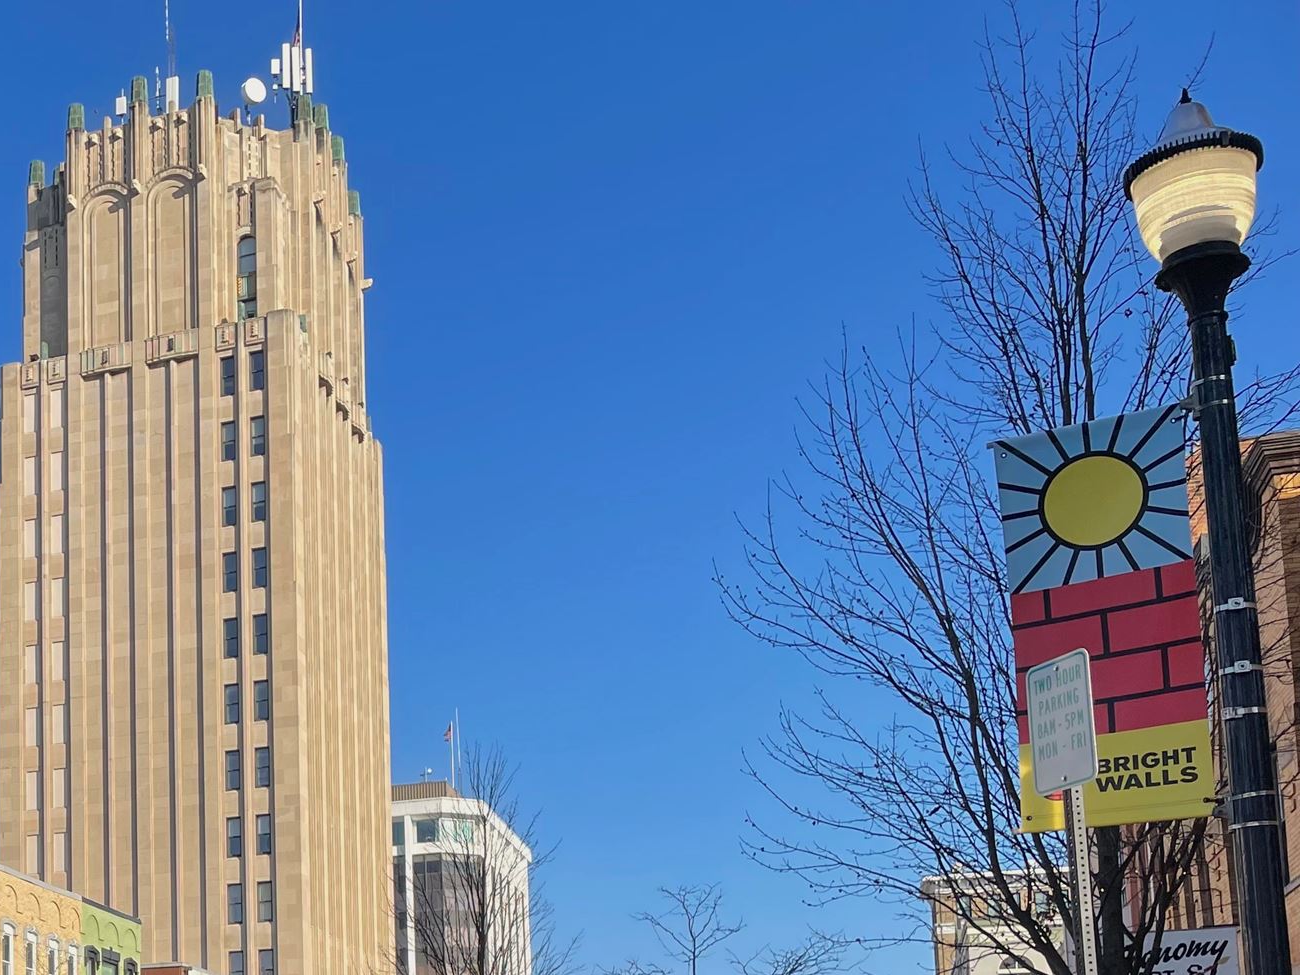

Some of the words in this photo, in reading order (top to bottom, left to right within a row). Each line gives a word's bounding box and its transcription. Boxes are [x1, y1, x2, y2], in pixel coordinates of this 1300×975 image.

[1034, 675, 1052, 695] TWO
[1055, 664, 1081, 688] HOUR
[1038, 688, 1079, 716] PARKING
[1037, 719, 1056, 739] 8AM
[1064, 709, 1084, 730] 5PM
[1038, 742, 1059, 761] MON
[1070, 731, 1087, 750] FRI
[1098, 746, 1197, 775] BRIGHT
[1095, 766, 1198, 792] WALLS
